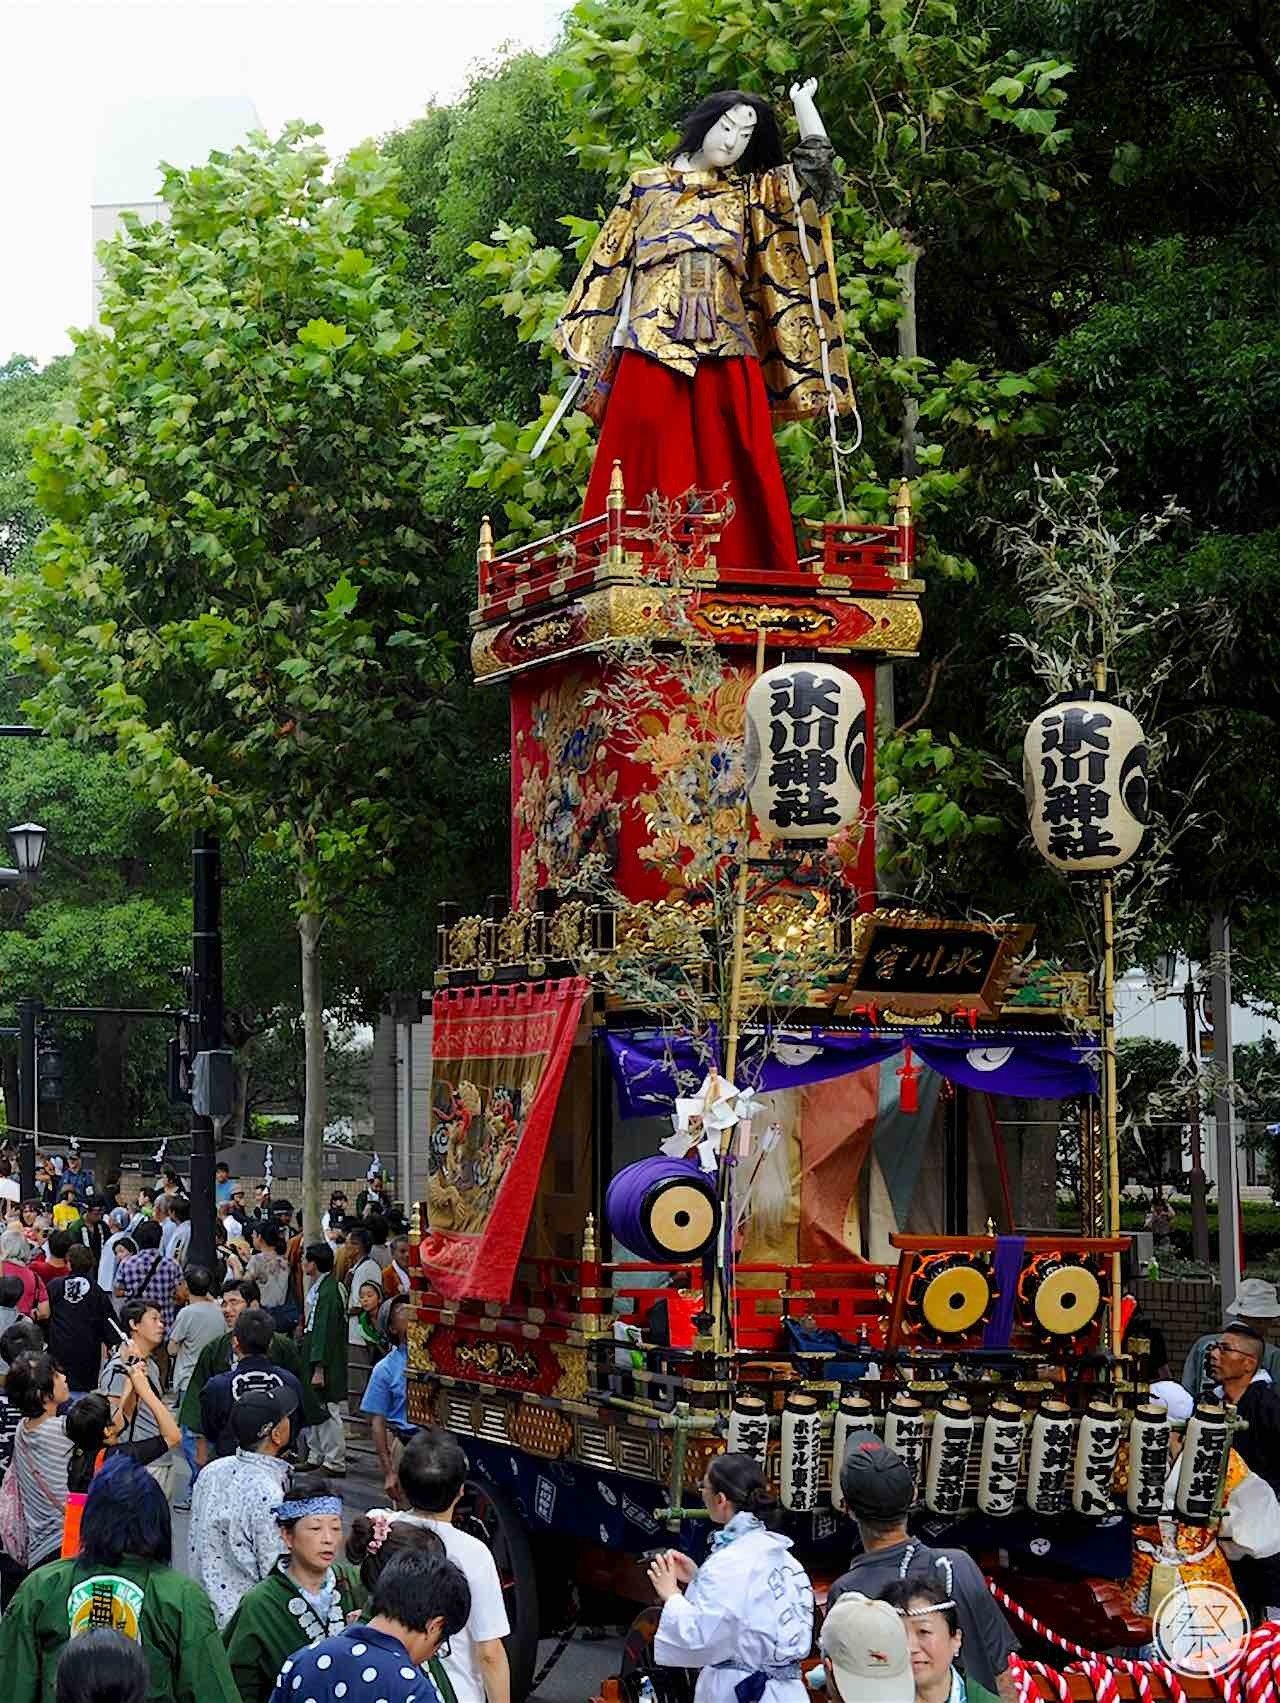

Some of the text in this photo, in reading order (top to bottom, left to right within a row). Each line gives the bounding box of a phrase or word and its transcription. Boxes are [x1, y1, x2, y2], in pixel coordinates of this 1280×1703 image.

[769, 671, 841, 828] 氷川神社
[1041, 708, 1122, 861] 氷川神社
